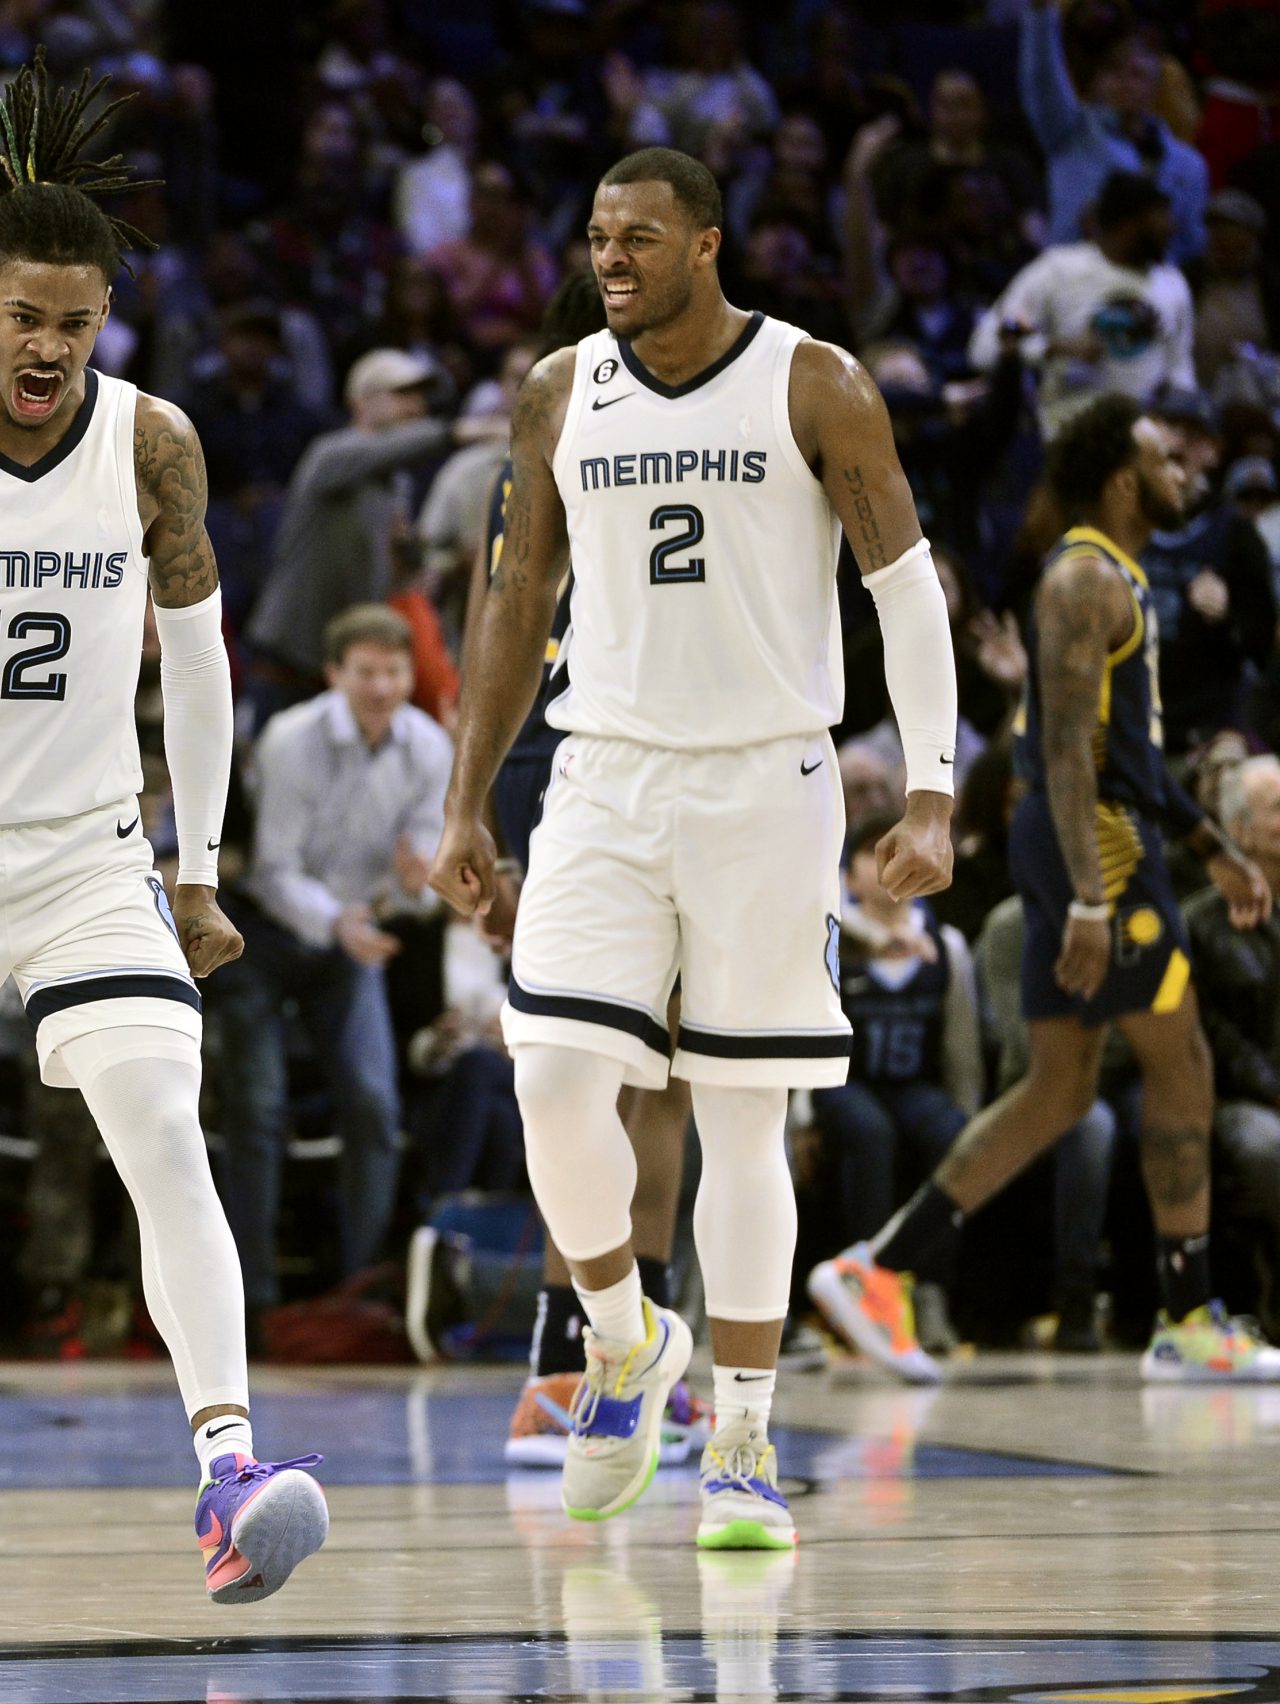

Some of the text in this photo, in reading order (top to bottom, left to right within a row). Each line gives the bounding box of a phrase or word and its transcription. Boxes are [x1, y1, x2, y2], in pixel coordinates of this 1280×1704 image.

[599, 360, 613, 383] 6
[580, 449, 767, 491] MEMPHIS
[649, 504, 706, 585] 2
